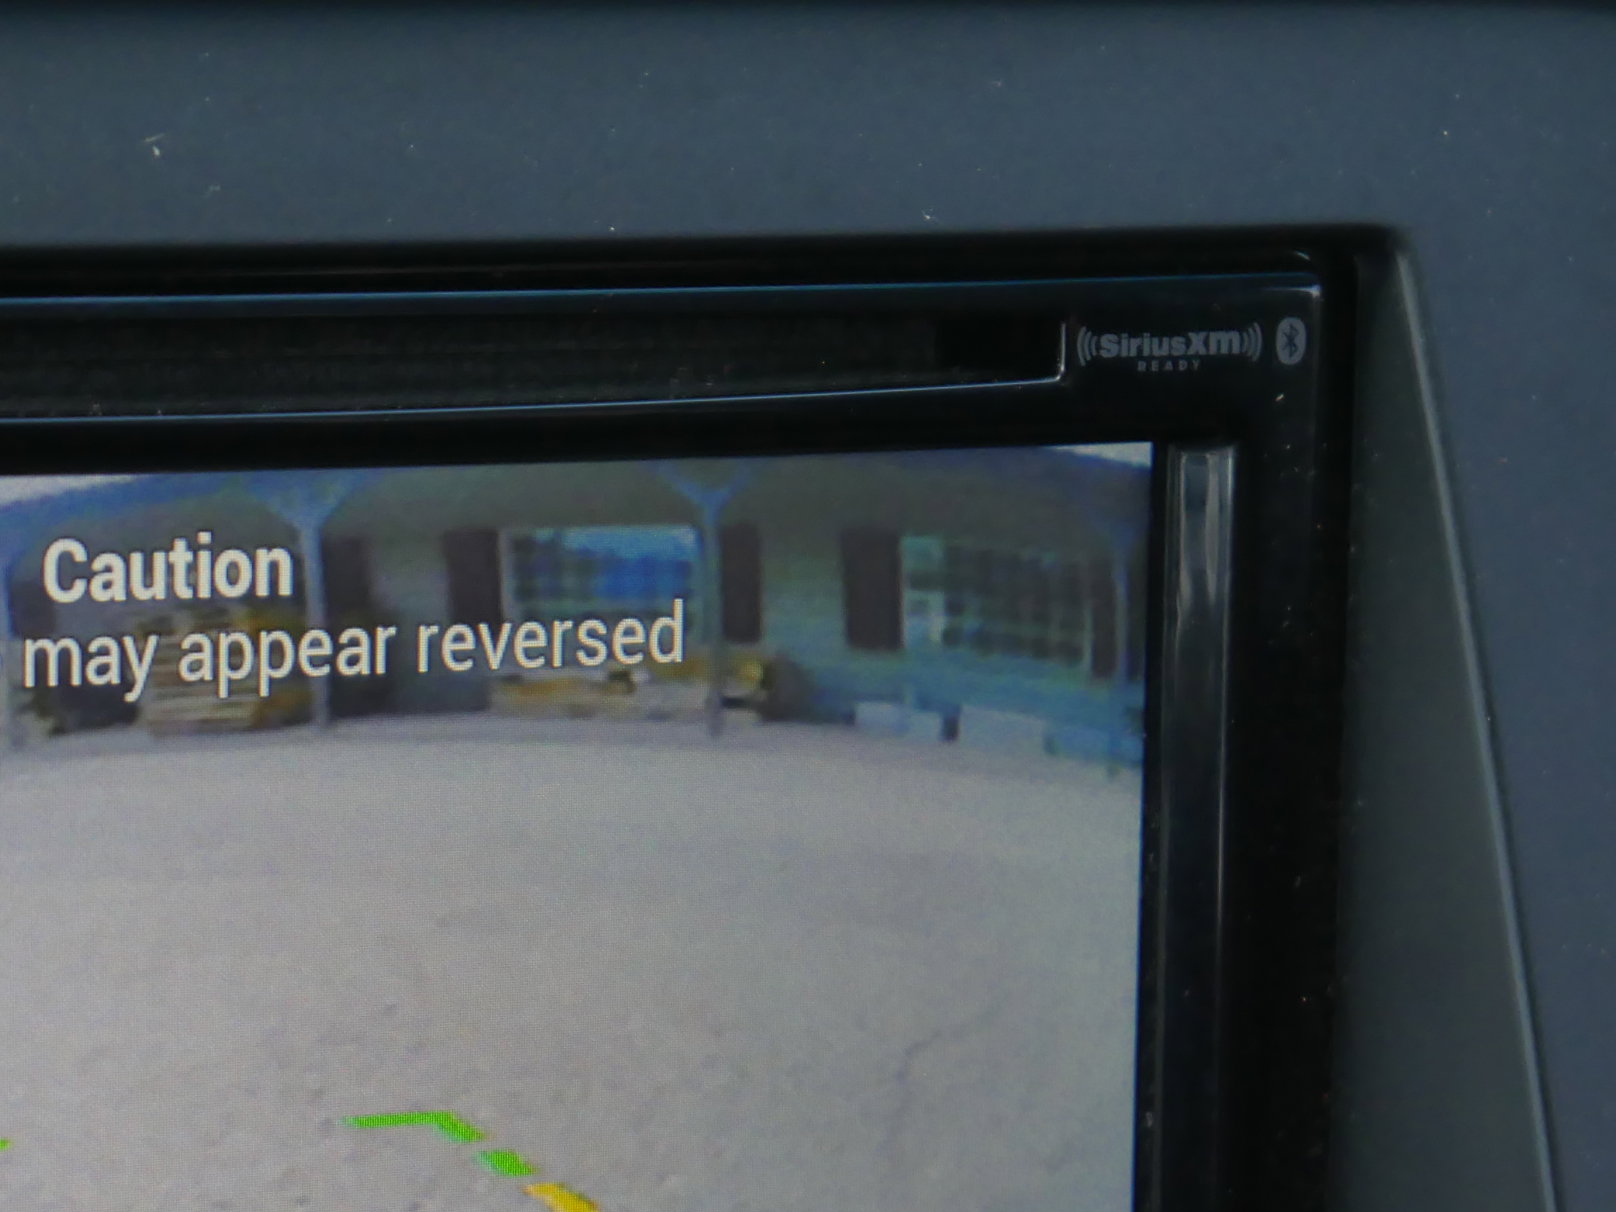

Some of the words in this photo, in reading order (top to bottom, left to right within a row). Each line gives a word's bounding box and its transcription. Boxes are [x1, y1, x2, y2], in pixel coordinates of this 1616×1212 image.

[1137, 360, 1202, 373] READY
[43, 530, 294, 603] Caution
[23, 633, 161, 702] may
[177, 624, 398, 699] appear
[416, 597, 685, 673] reversed
